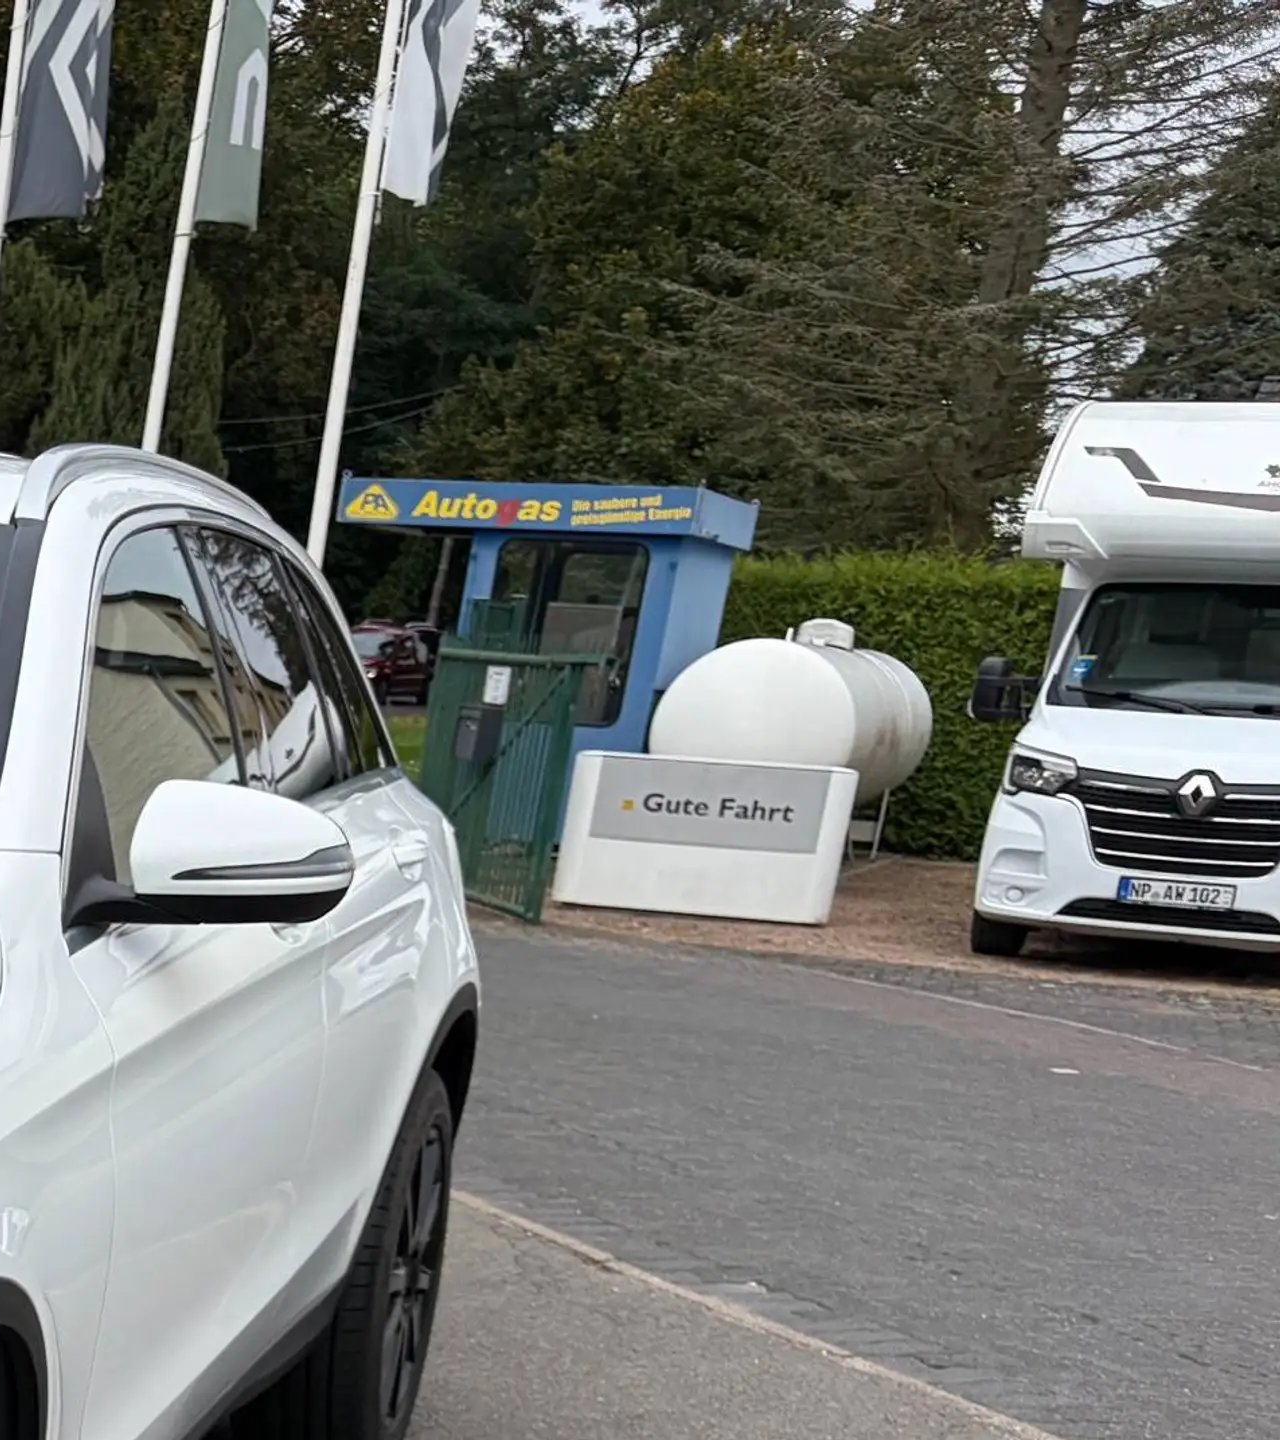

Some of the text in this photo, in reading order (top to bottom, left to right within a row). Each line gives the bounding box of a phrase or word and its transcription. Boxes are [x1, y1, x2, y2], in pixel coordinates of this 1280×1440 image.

[411, 489, 562, 526] Autogas
[643, 793, 794, 823] Gute Fahrt
[1130, 881, 1152, 898] NP
[1187, 888, 1221, 905] 102
